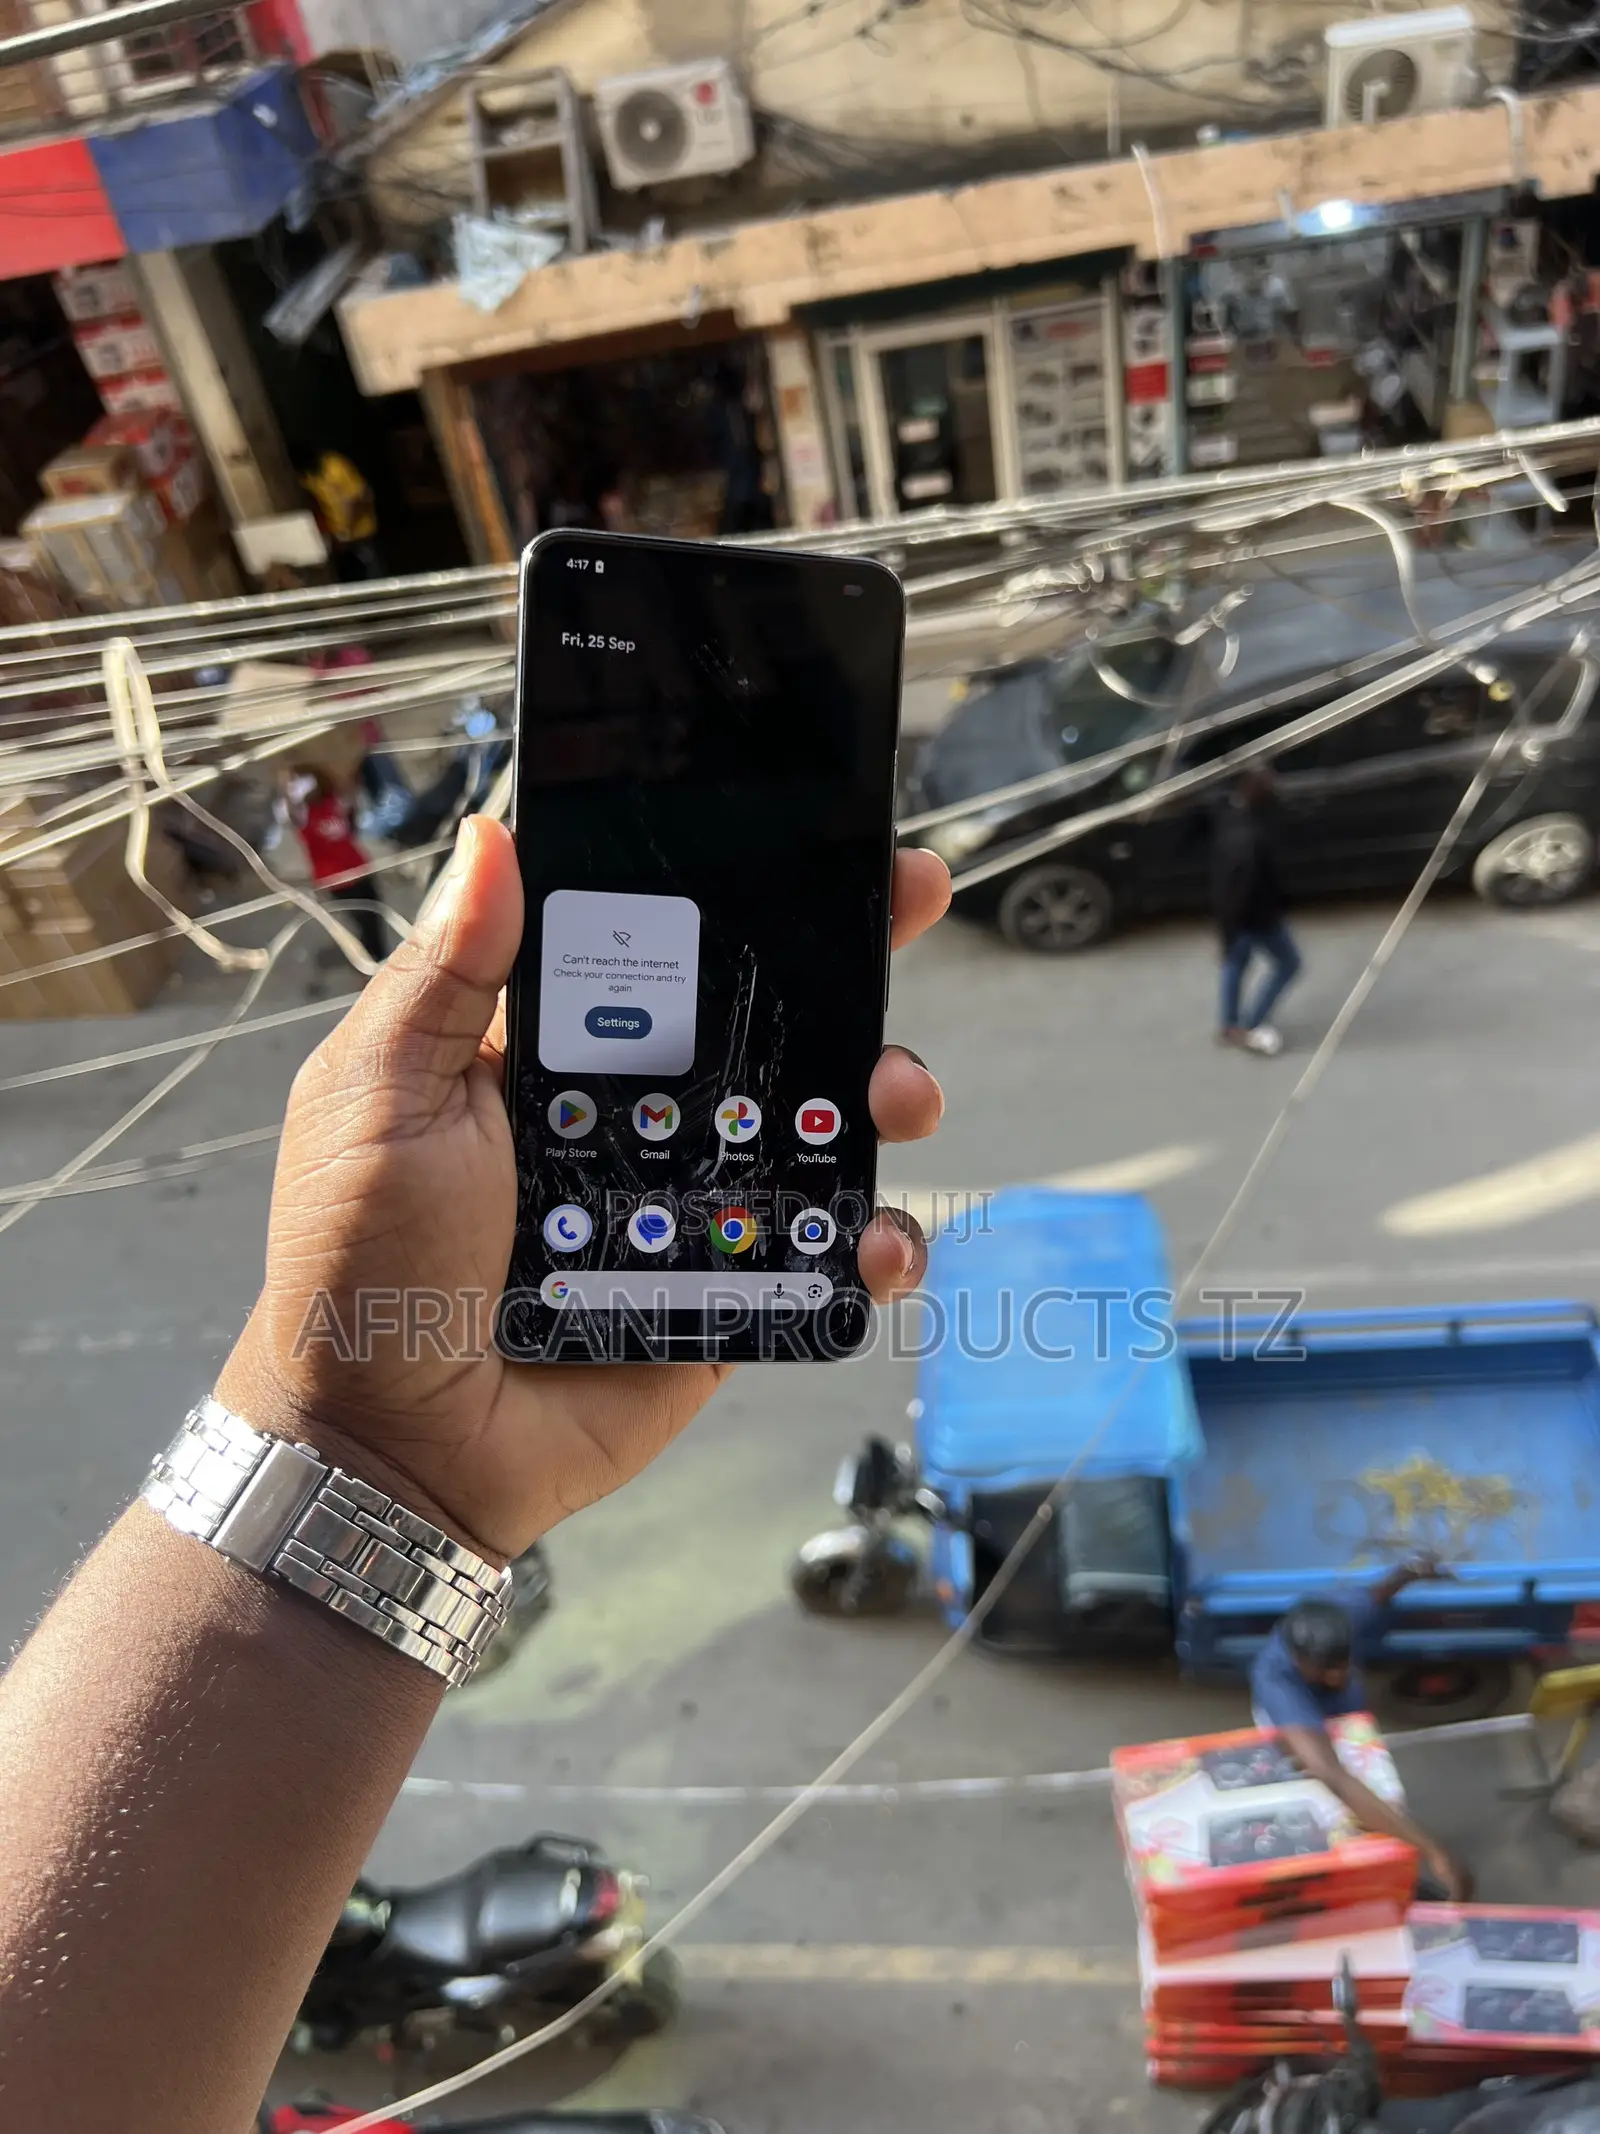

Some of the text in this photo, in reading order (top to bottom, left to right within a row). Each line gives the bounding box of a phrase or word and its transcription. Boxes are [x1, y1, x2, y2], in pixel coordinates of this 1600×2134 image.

[566, 558, 589, 570] 4:17
[562, 632, 635, 654] Fri, 25 Sep
[562, 954, 679, 970] Can't reach the internet
[553, 968, 687, 985] Check your connection and try
[608, 984, 632, 993] again
[597, 1017, 640, 1030] Settings
[545, 1147, 598, 1160] Play Store
[640, 1149, 670, 1160] Gmail
[720, 1151, 755, 1162] Photos
[796, 1153, 837, 1164] YouTube
